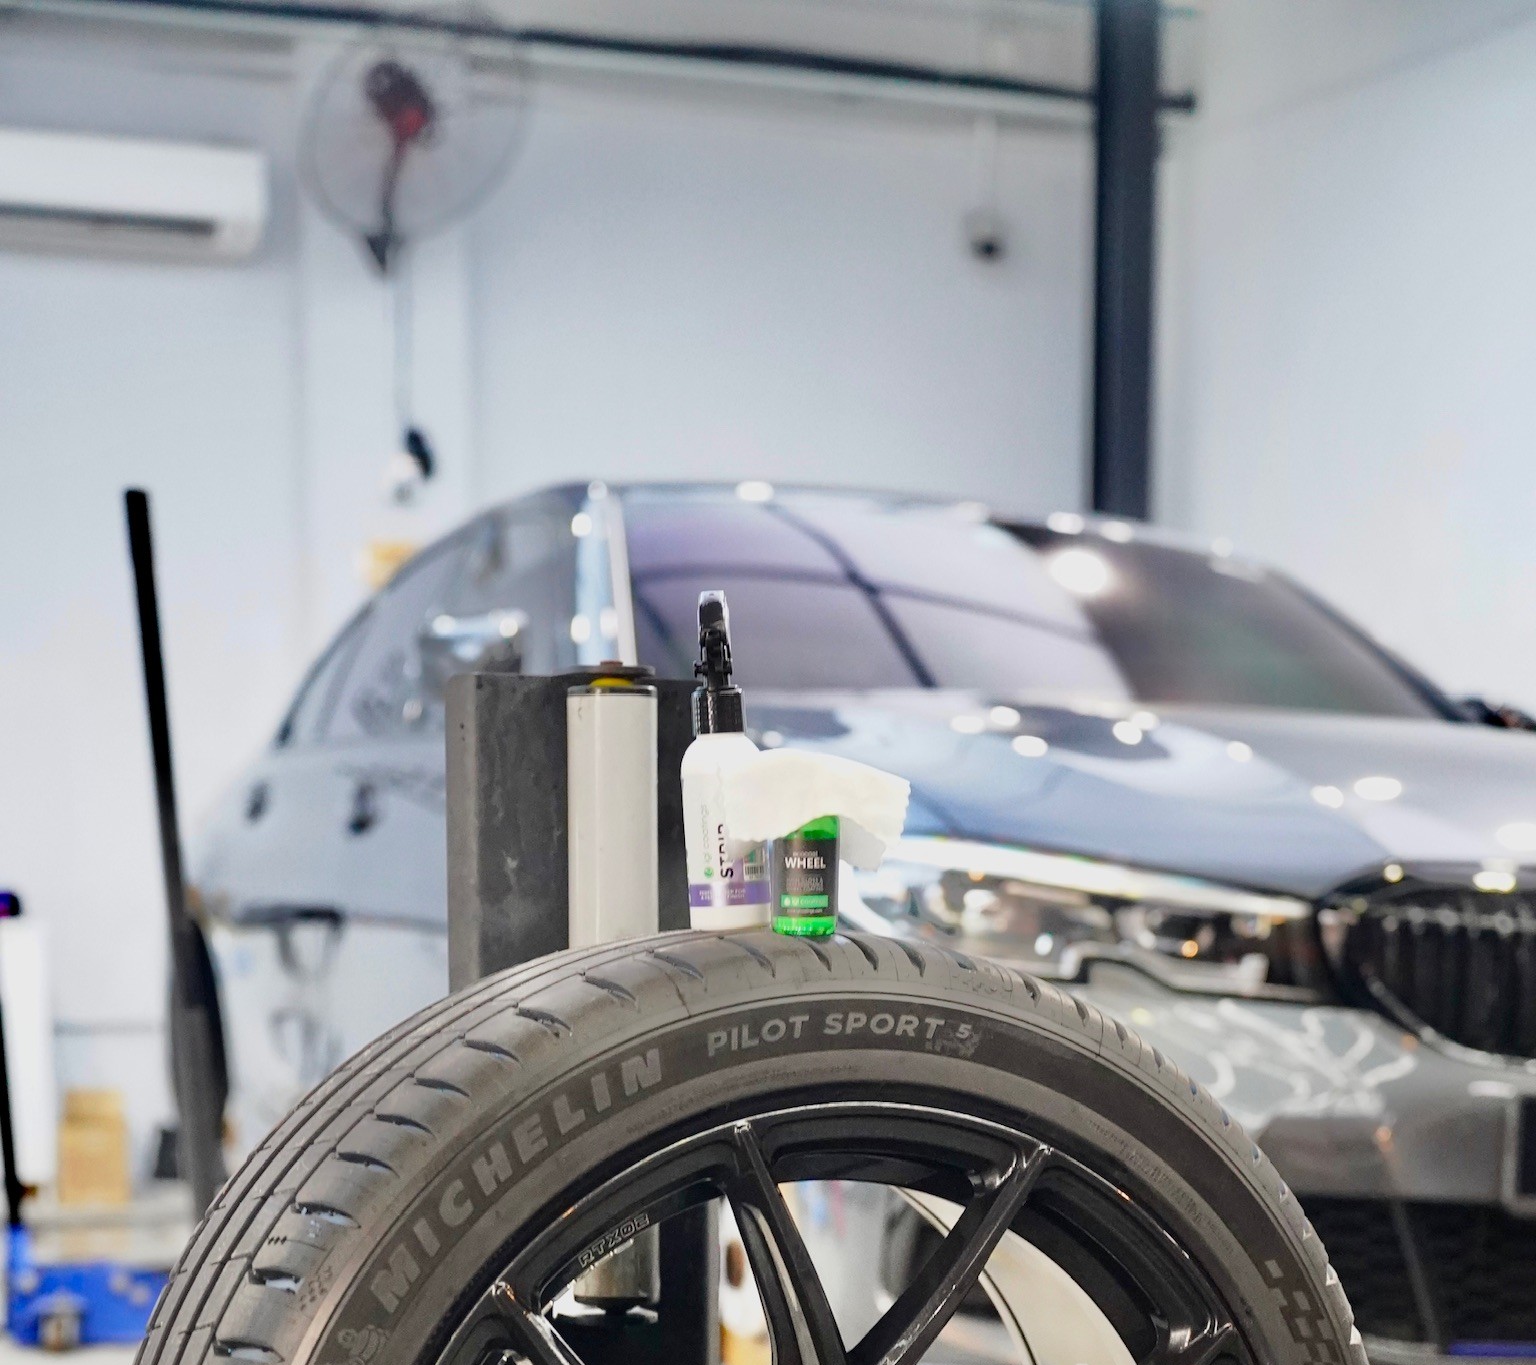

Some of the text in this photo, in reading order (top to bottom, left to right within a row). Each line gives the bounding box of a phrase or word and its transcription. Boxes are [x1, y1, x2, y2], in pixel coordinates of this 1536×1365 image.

[784, 856, 827, 869] WHEEL
[707, 1012, 973, 1057] PILOT SPORT 5
[370, 1048, 663, 1314] MICHELIN
